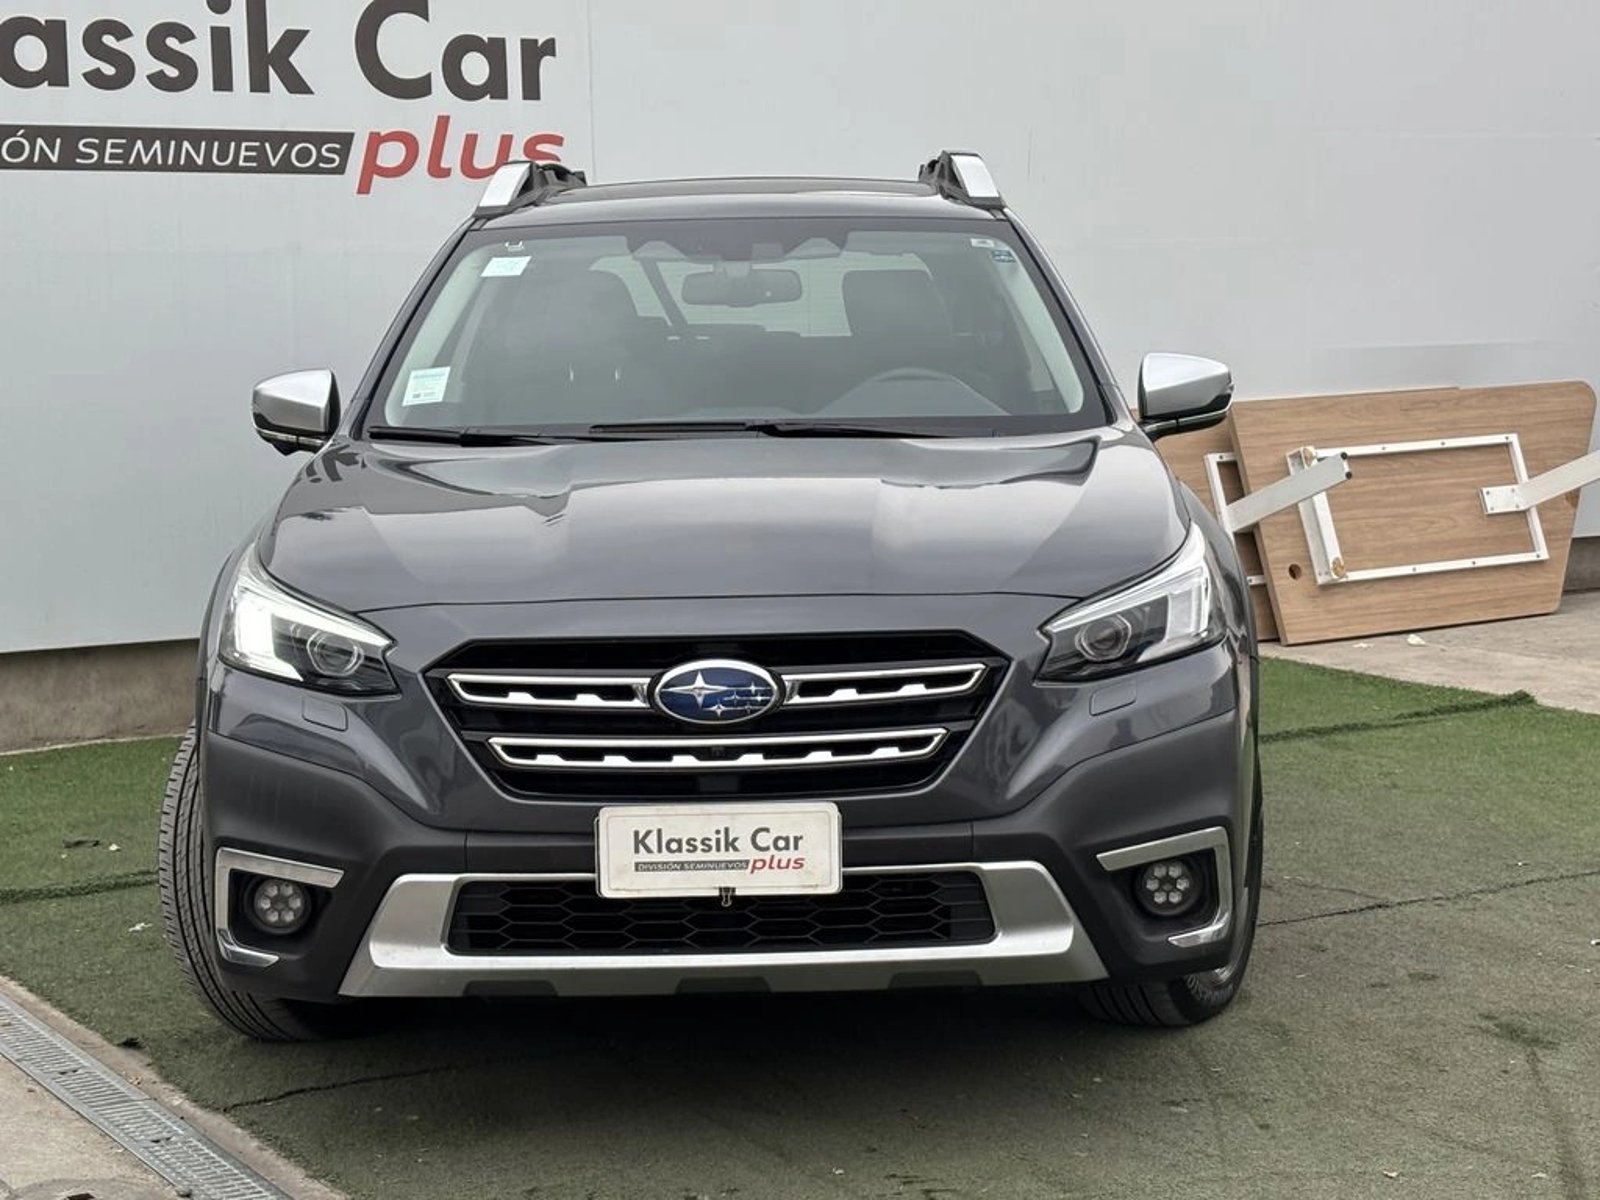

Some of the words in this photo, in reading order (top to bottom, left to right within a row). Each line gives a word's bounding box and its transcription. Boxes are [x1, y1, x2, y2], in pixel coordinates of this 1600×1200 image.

[354, 0, 557, 101] Car
[1, 129, 61, 163] ÓN
[75, 137, 342, 168] SEMINUEVOS
[356, 115, 565, 194] plus
[633, 827, 740, 853] Klassik
[750, 827, 804, 852] Car
[638, 862, 682, 871] DIVISIÓN
[684, 861, 748, 870] SEMINUEVOS
[750, 854, 805, 874] plus
